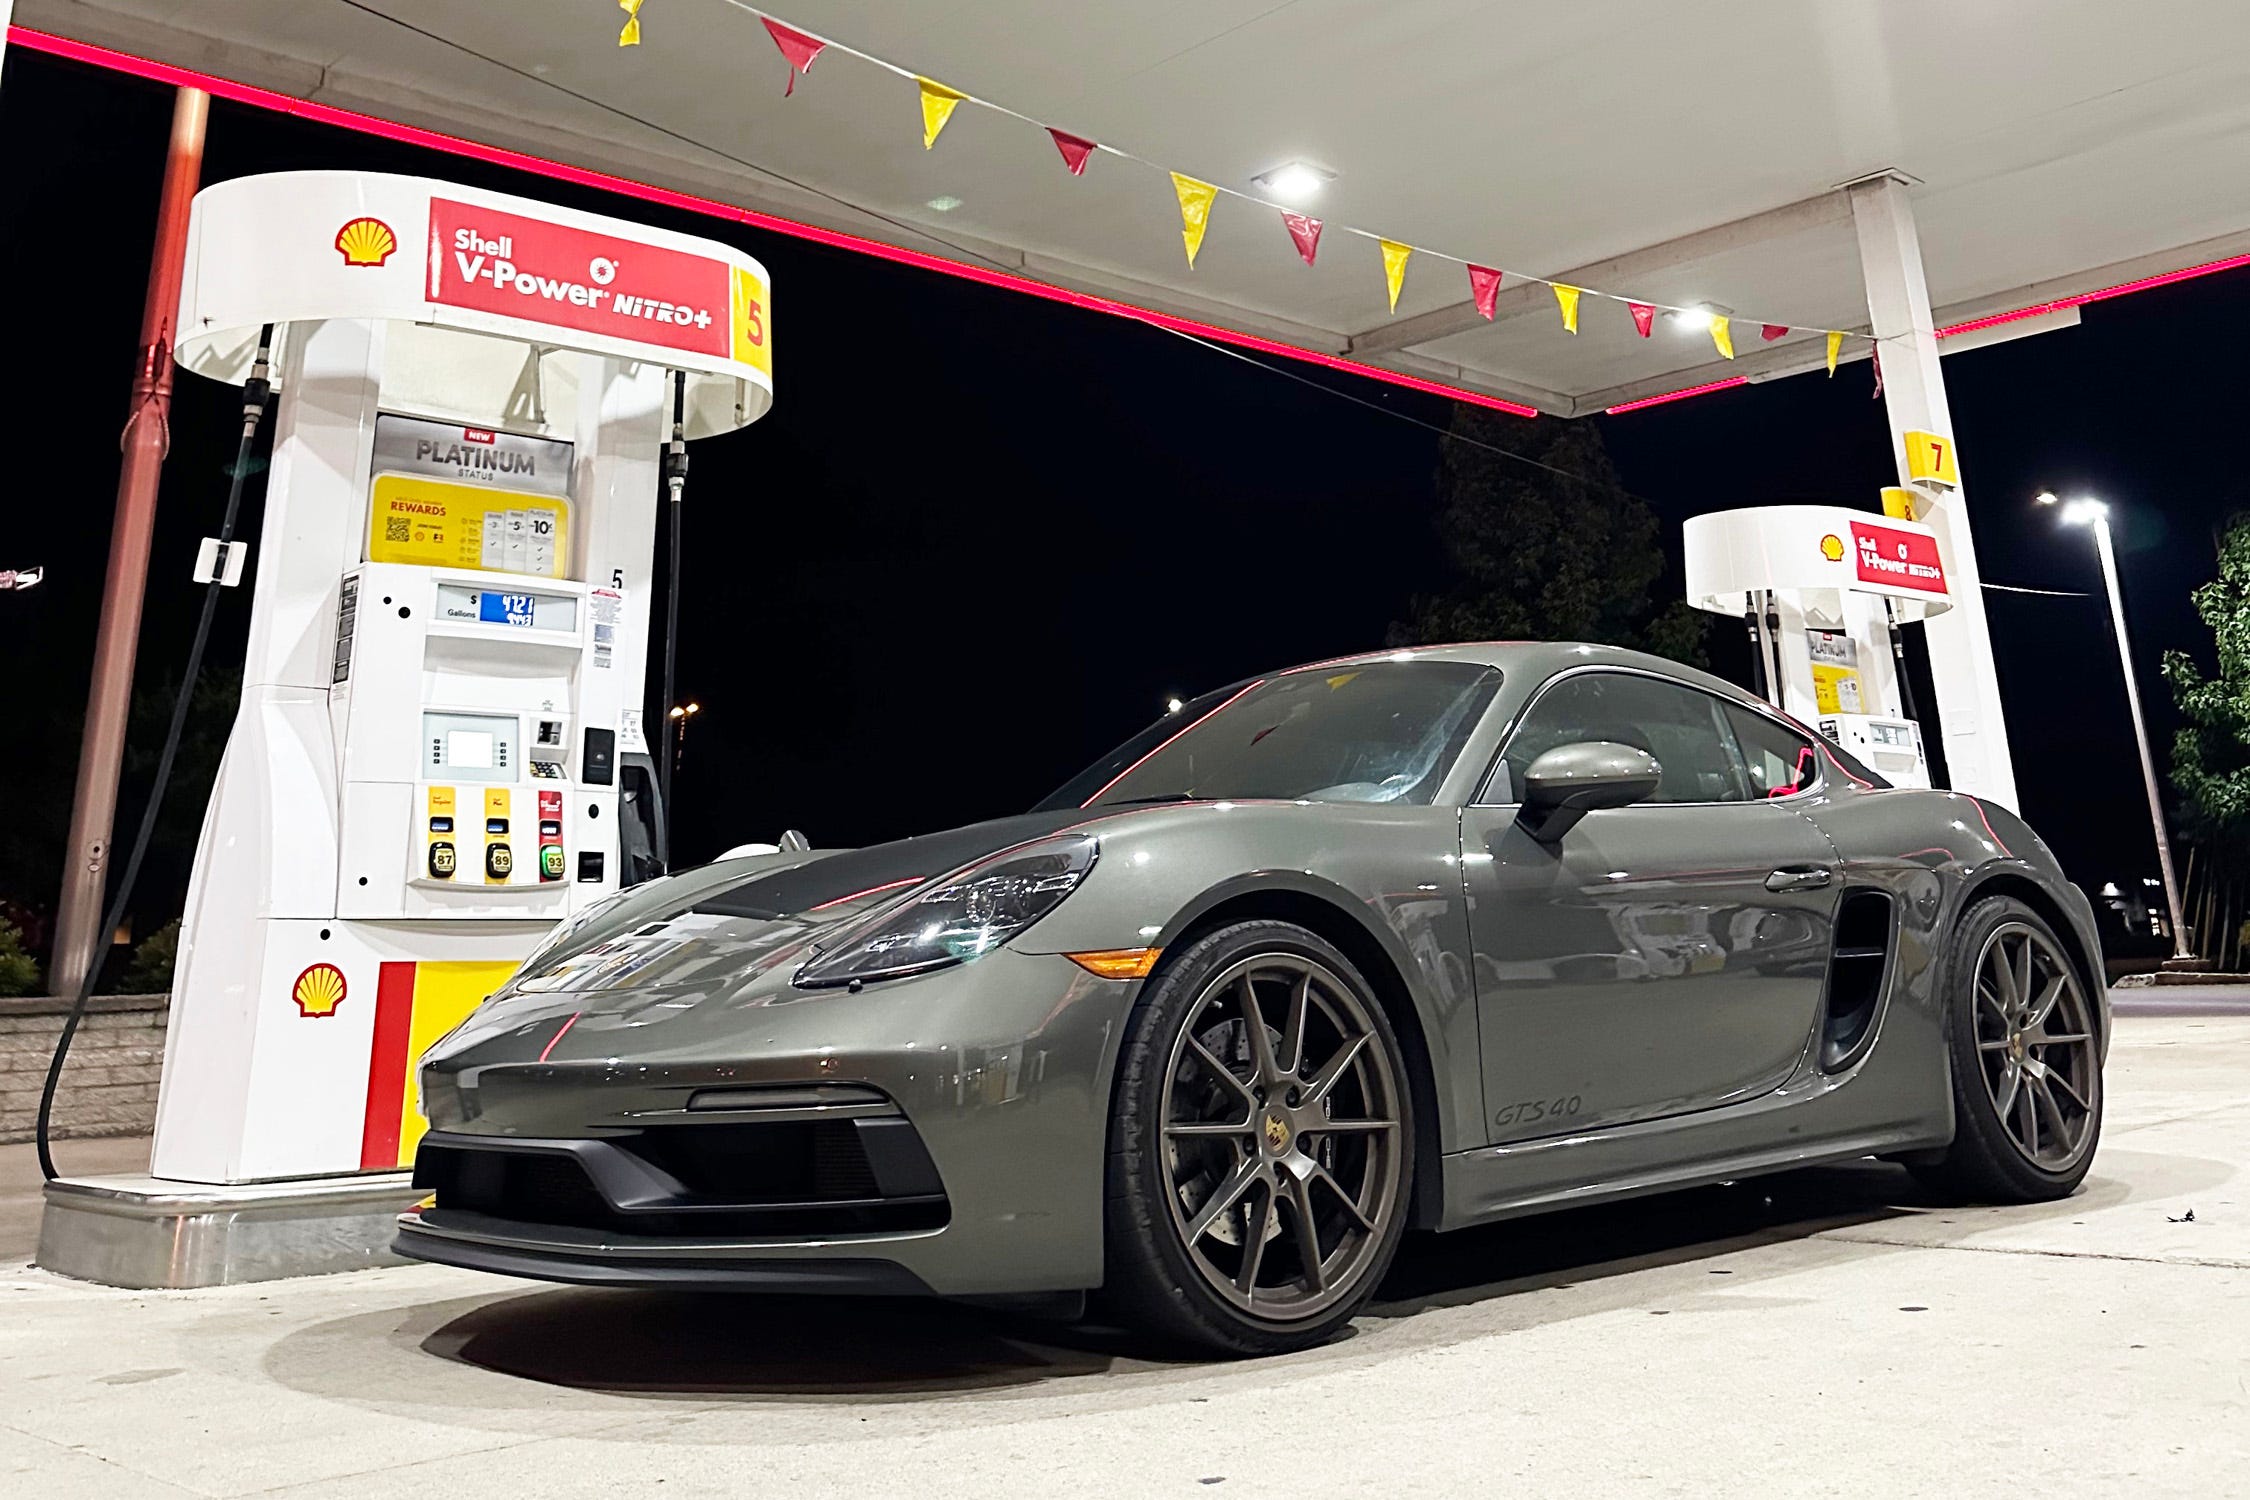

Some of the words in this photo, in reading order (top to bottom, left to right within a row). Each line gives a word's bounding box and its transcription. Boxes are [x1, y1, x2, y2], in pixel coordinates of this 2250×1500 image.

[454, 228, 512, 259] Shell
[454, 251, 604, 308] V-Power
[747, 299, 763, 346] 5
[468, 431, 491, 441] NEW
[416, 440, 535, 476] PLATINUM
[1930, 443, 1943, 472] 7
[458, 468, 493, 481] STATUS
[391, 501, 446, 516] REWARDS
[1860, 550, 1907, 574] V-Power
[612, 569, 623, 589] 5
[447, 609, 476, 618] Gallons
[437, 855, 453, 865] 87
[494, 855, 510, 866] 89
[548, 857, 563, 867] 93
[1495, 1100, 1546, 1126] GTS
